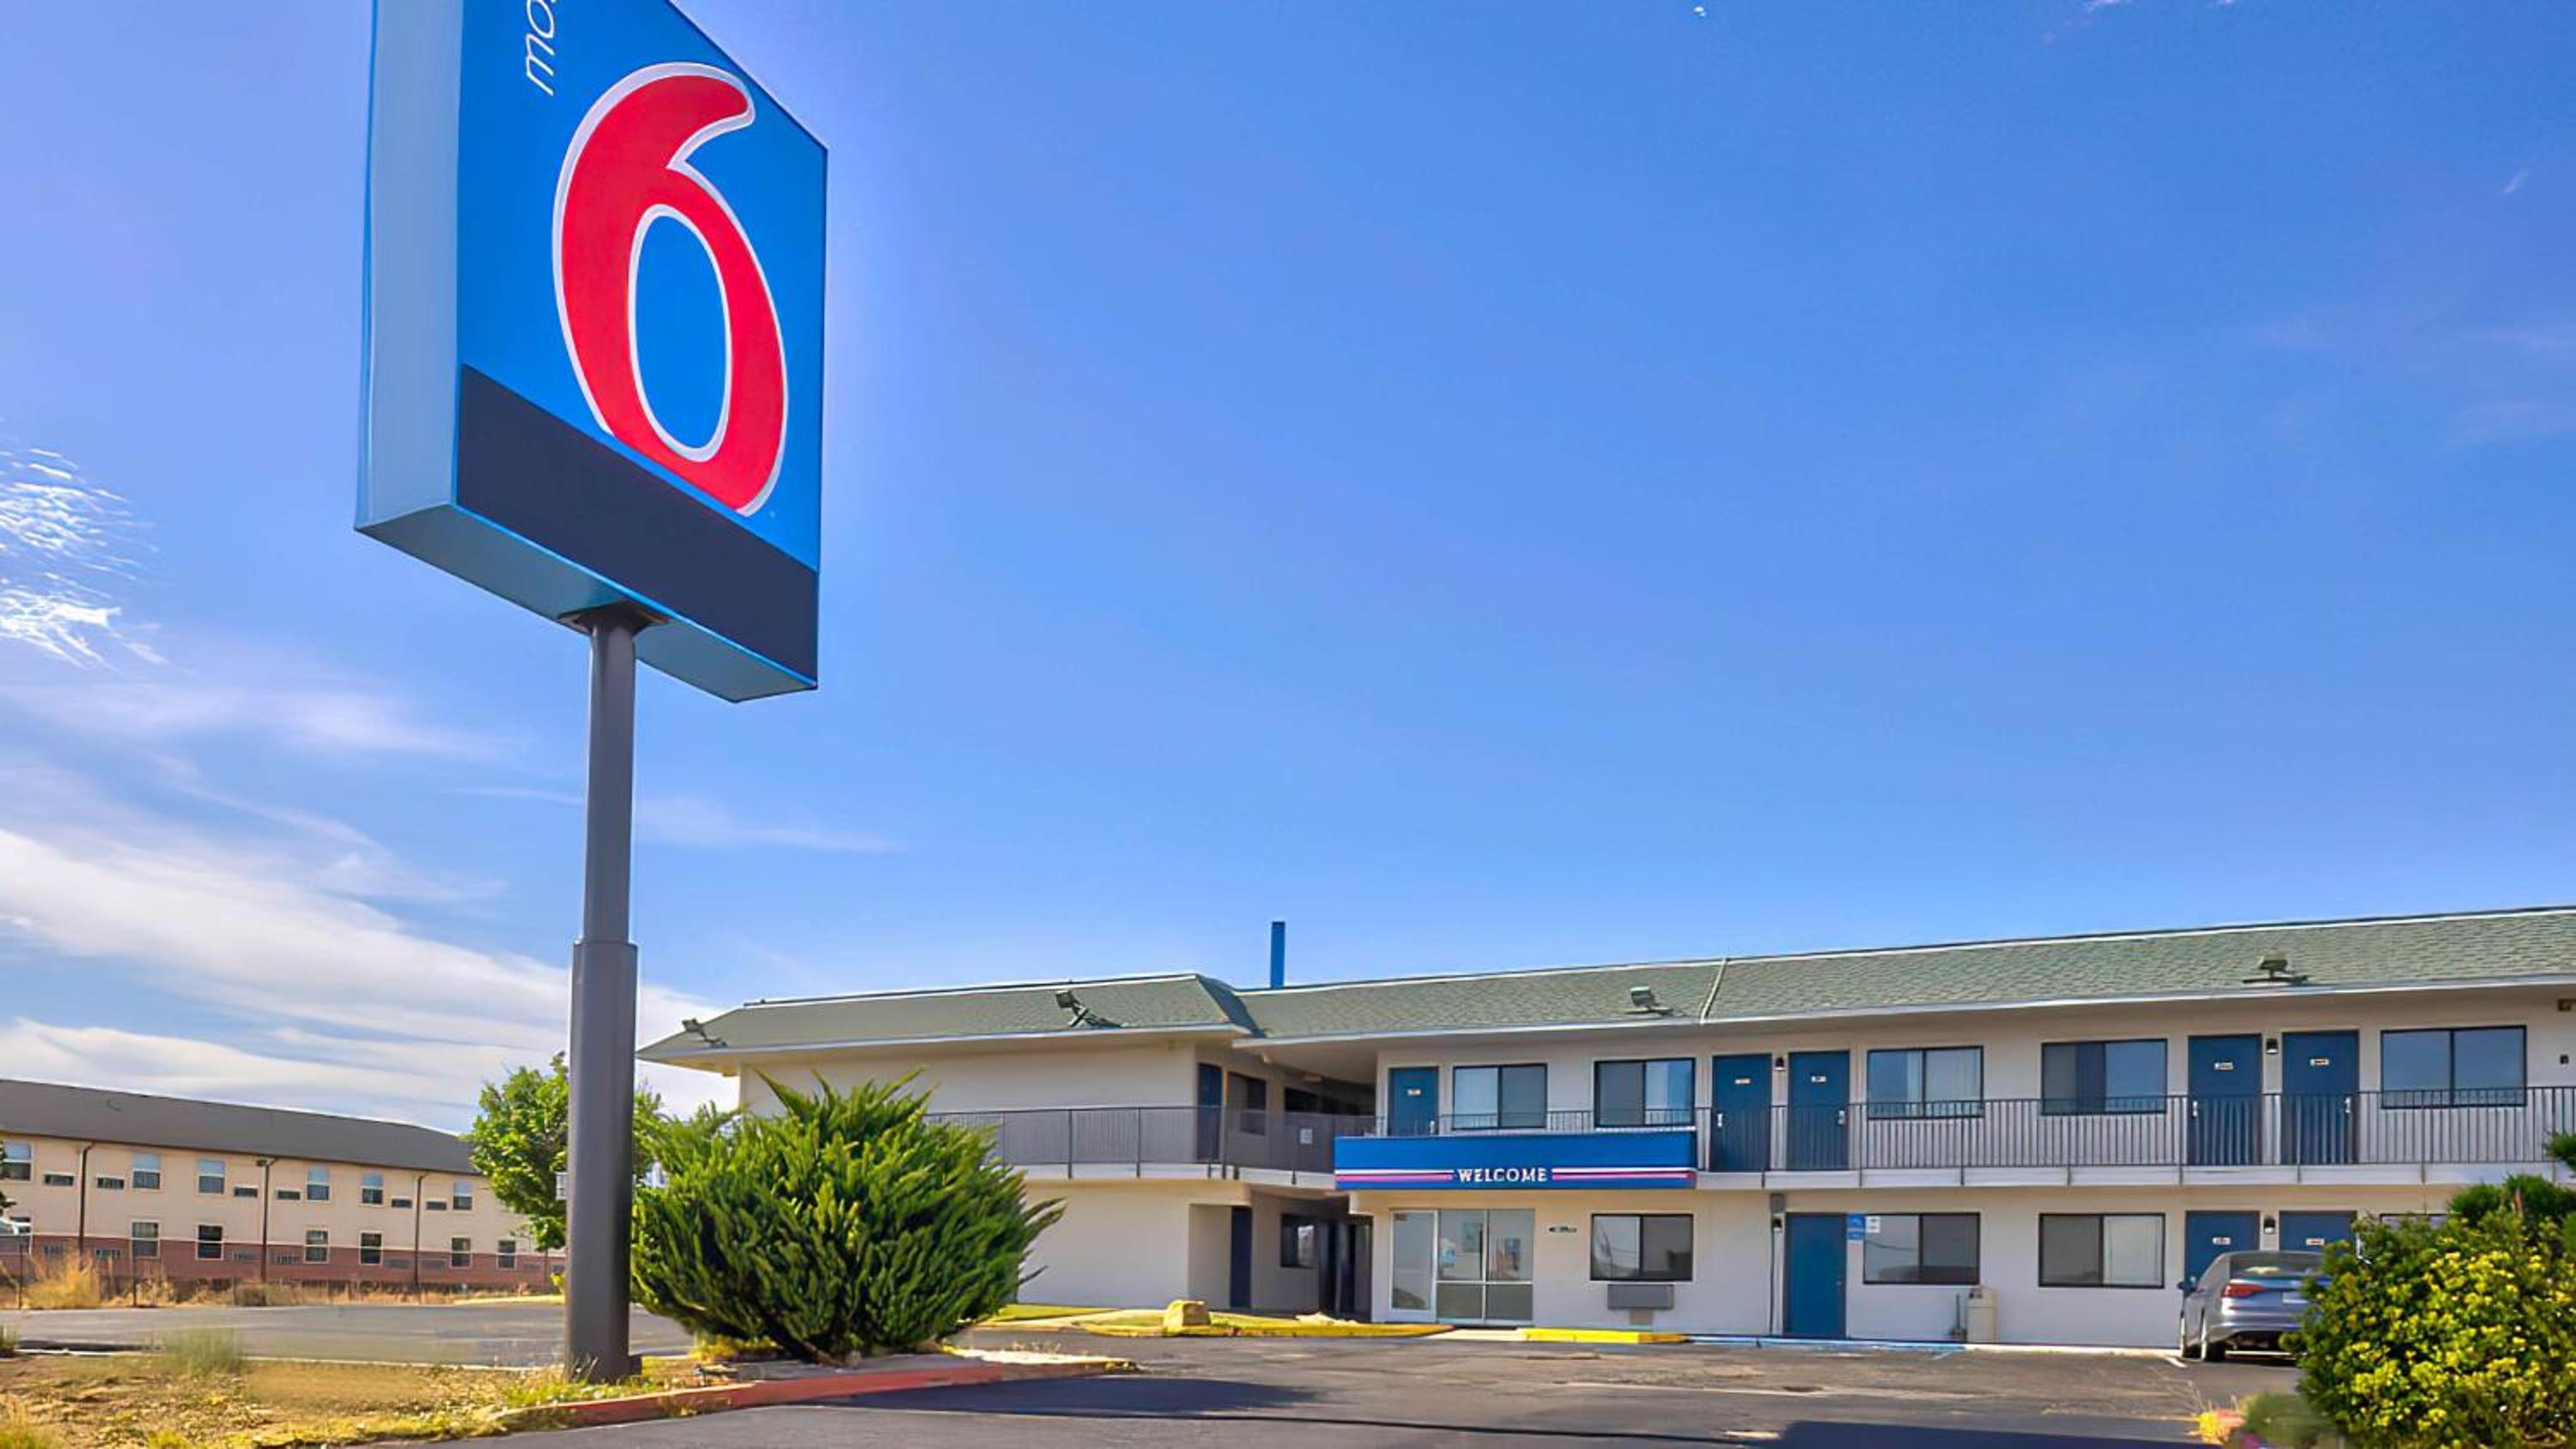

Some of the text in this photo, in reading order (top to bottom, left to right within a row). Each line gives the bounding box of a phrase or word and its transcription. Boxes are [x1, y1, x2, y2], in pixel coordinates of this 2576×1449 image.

[526, 0, 556, 96] mo
[552, 62, 789, 518] 6
[1457, 1167, 1547, 1182] WELCOME
